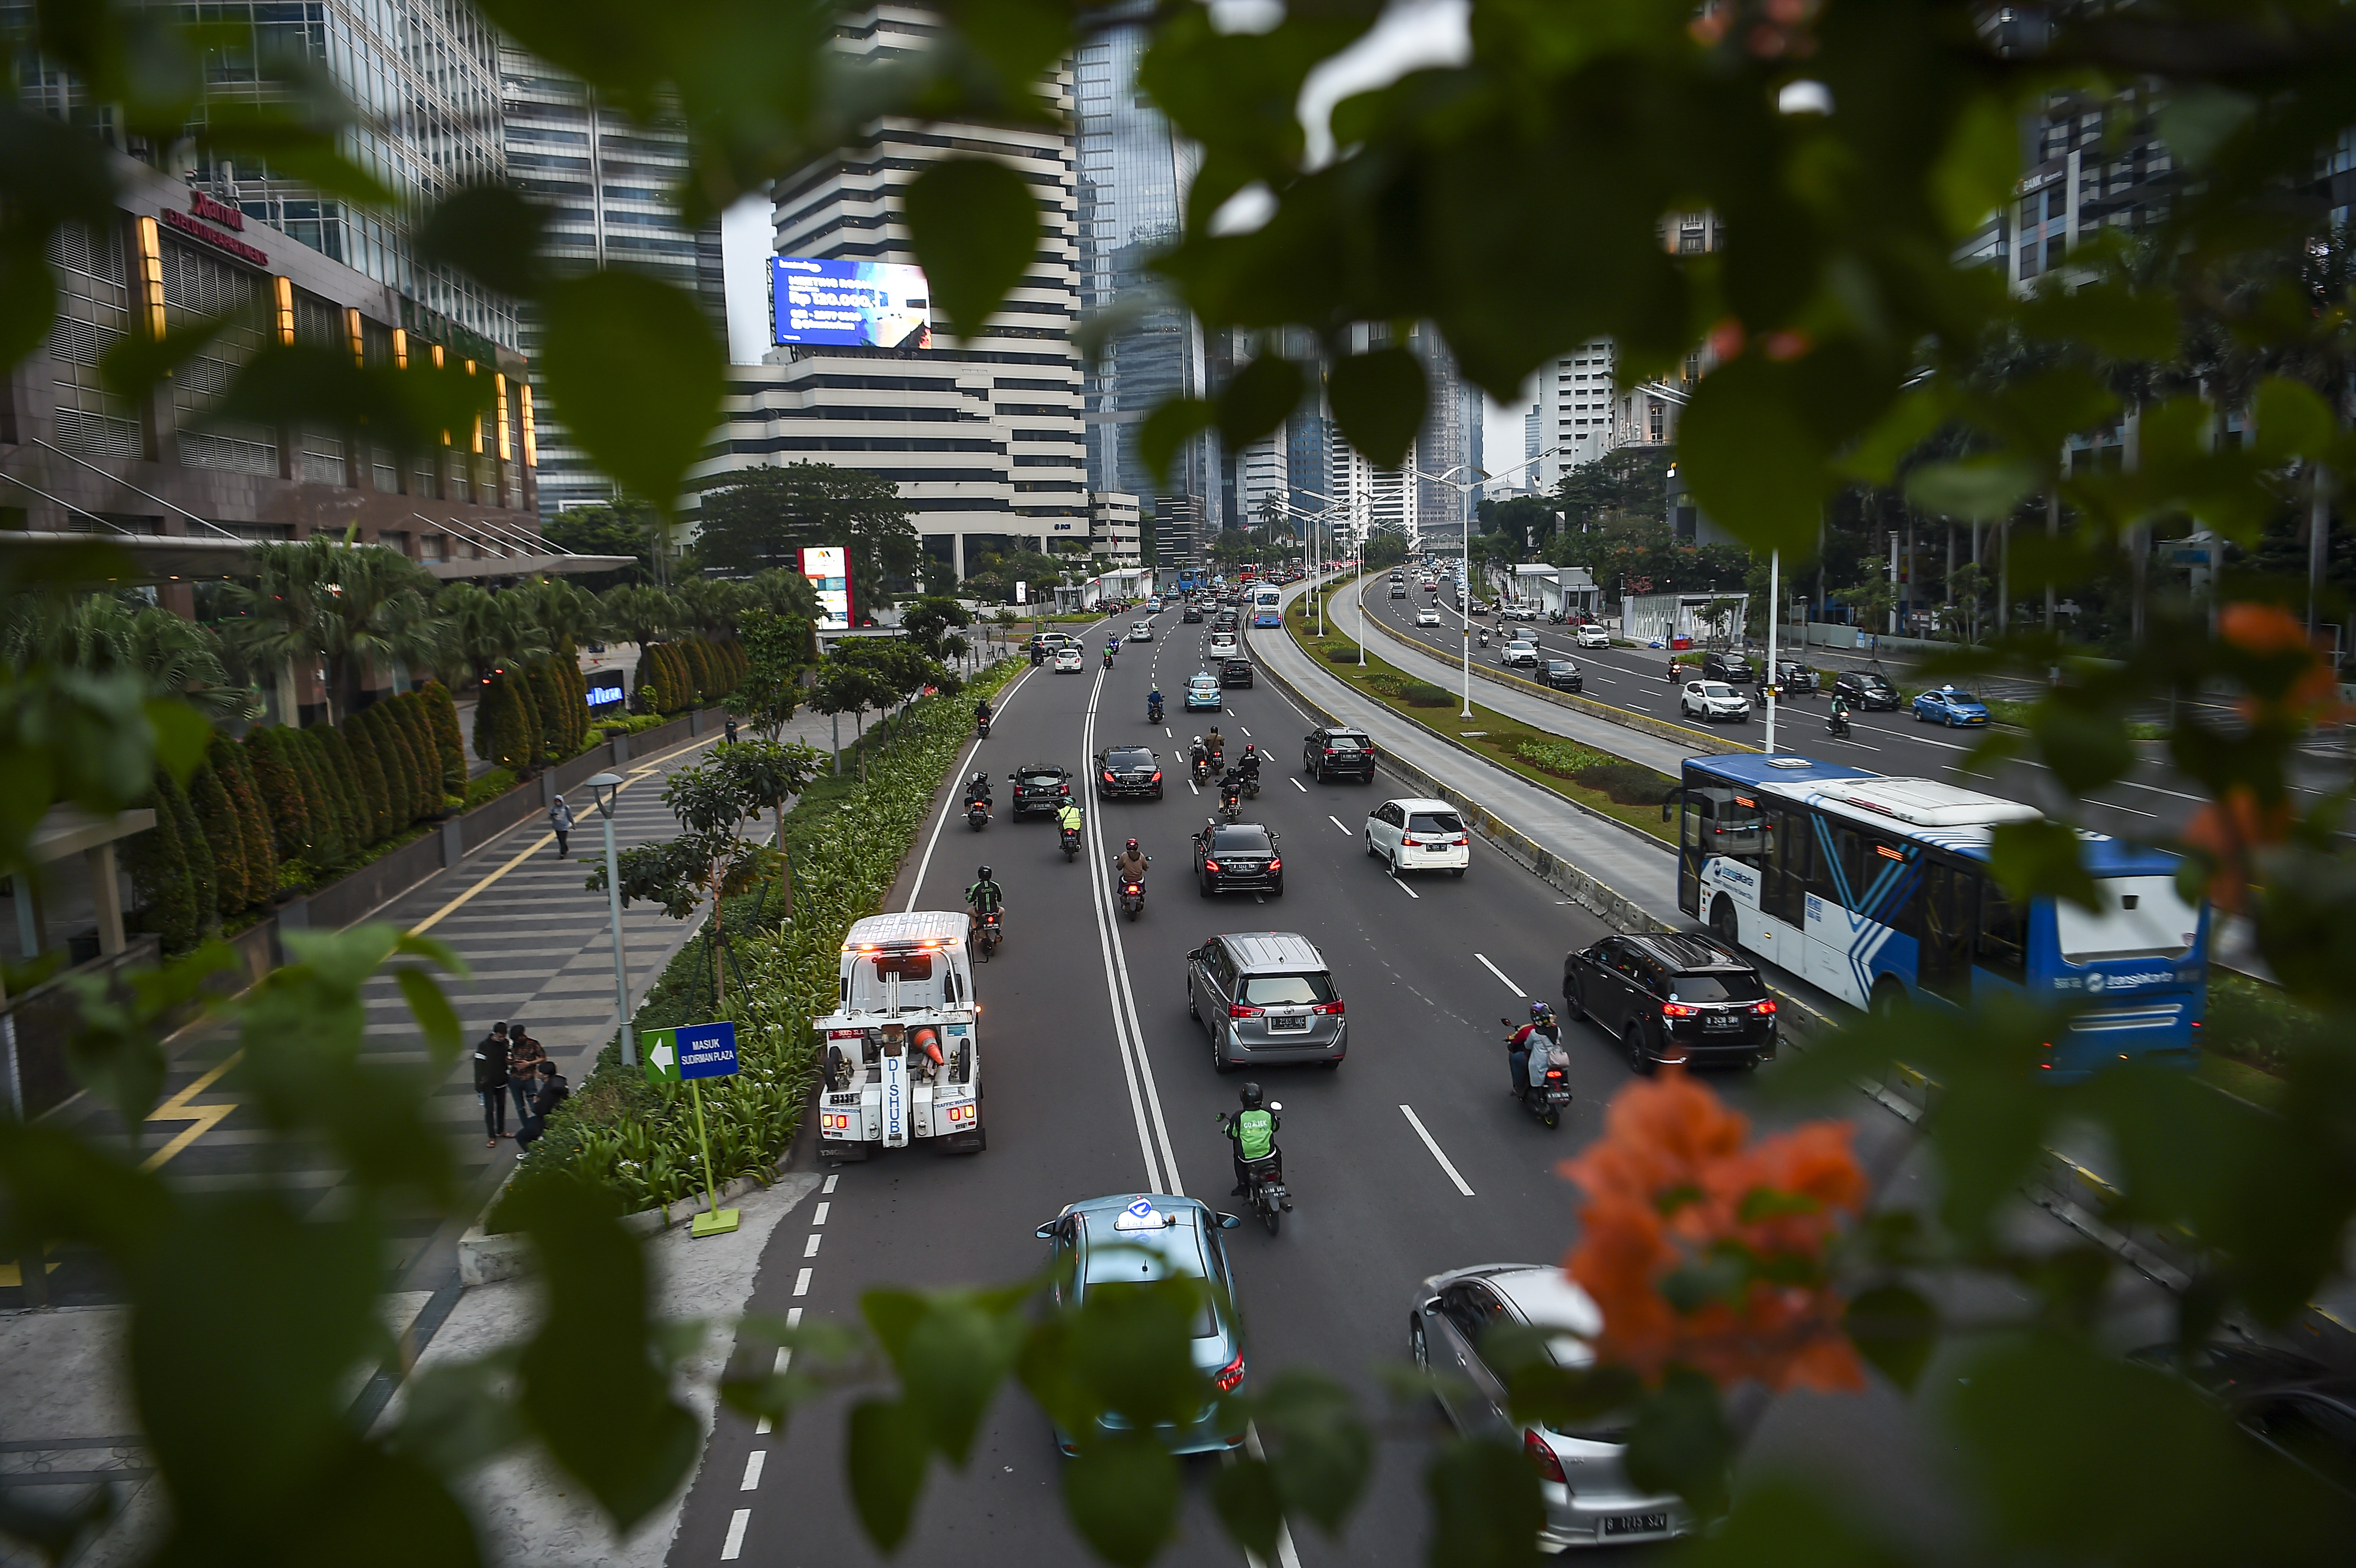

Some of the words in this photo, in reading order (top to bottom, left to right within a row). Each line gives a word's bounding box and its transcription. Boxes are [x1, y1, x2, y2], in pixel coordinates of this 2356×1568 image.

[2023, 174, 2042, 191] BANK
[193, 190, 244, 231] Marriott
[165, 207, 219, 246] EXECUTIVE
[216, 231, 269, 266] APARTMENTS
[788, 275, 839, 288] MEETING
[839, 278, 872, 290] ROOM
[691, 1038, 720, 1051] MASUK
[681, 1052, 713, 1066] SUDIRMAN
[713, 1050, 734, 1061] PLAZA
[888, 1058, 900, 1133] DISHUB
